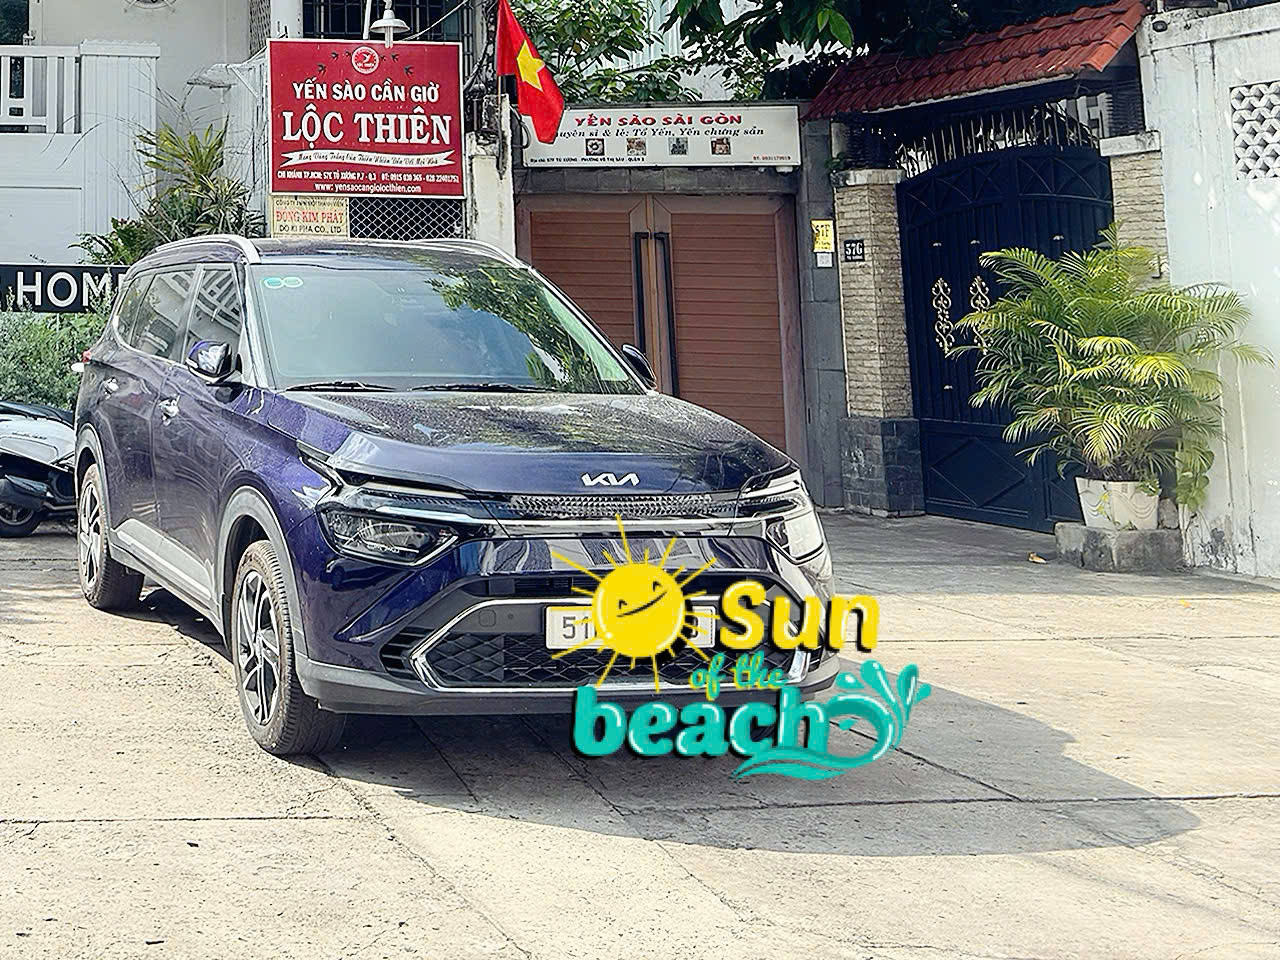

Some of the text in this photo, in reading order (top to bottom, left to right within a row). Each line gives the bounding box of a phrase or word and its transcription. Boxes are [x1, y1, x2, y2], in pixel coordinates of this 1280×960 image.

[292, 77, 440, 103] YẾN SÀO CẦN GIỜ
[282, 103, 452, 149] LỘC THIÊN
[618, 113, 657, 126] SÀO
[662, 113, 693, 126] SÀI
[700, 112, 742, 125] GÒN
[602, 128, 612, 137] &
[302, 211, 319, 223] KIM
[845, 242, 863, 256] 57G
[582, 473, 640, 487] KIA
